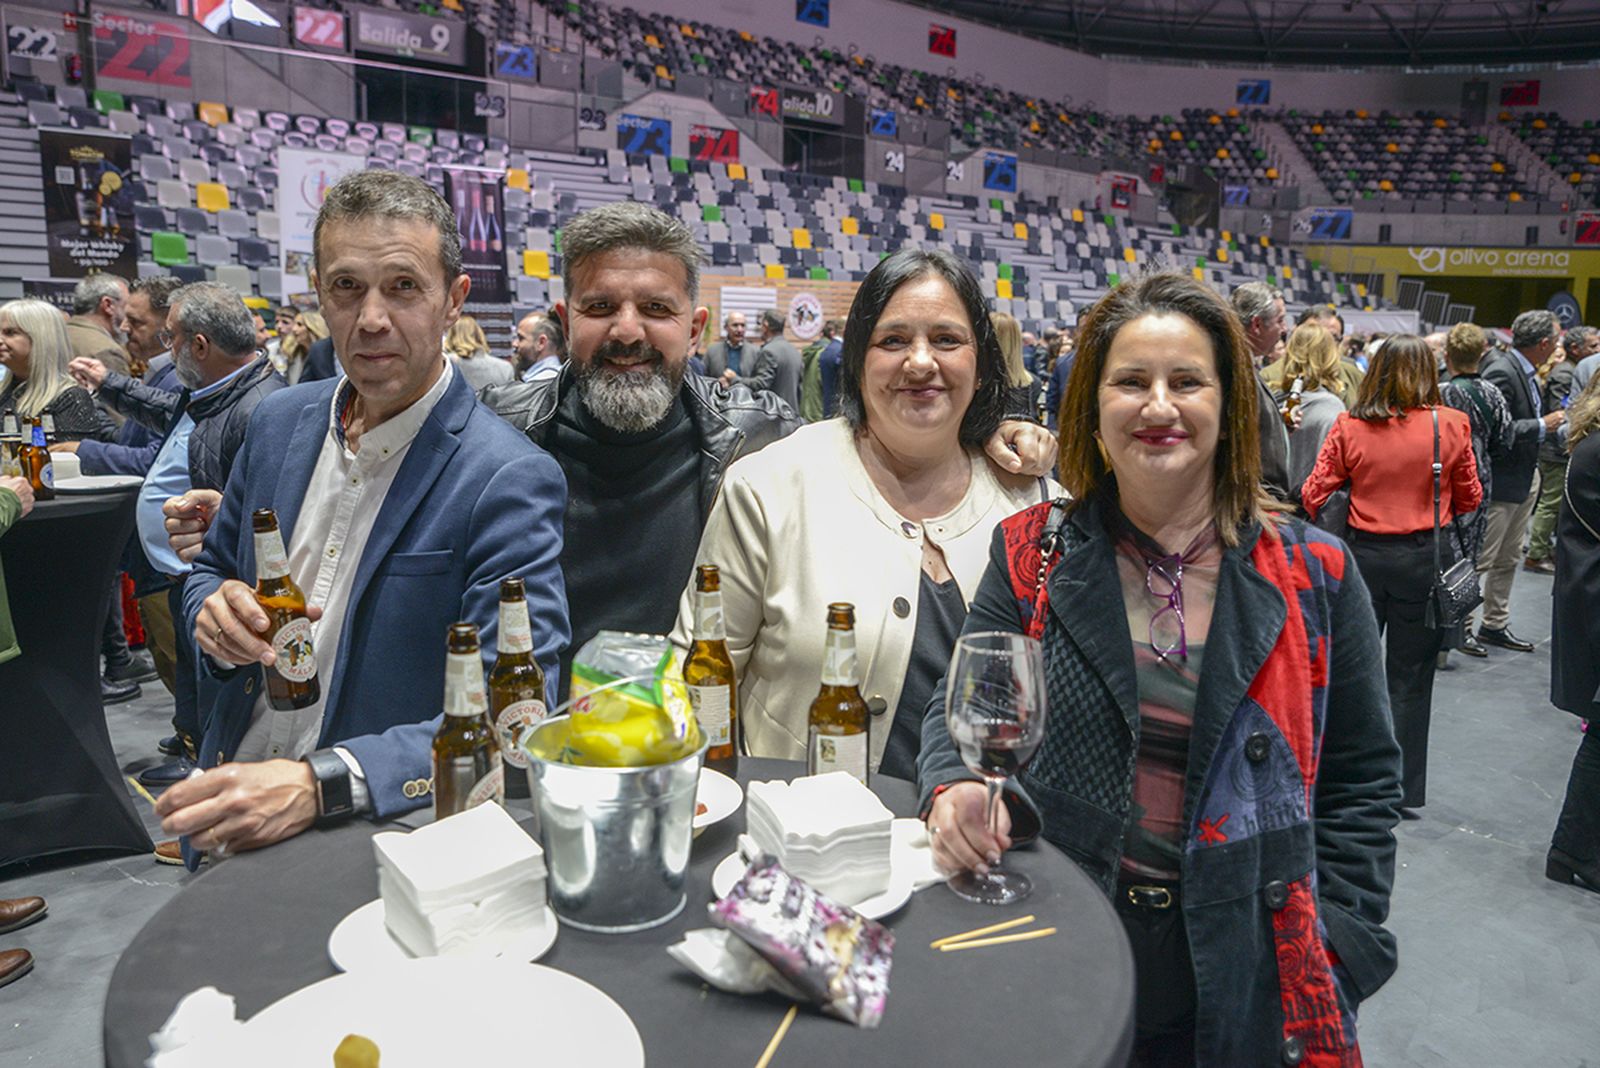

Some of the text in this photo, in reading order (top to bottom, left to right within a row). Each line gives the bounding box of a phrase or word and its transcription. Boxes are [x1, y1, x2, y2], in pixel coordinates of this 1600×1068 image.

[94, 13, 156, 36] Sector
[293, 9, 344, 49] 22
[358, 20, 450, 52] Salida 9
[8, 26, 58, 62] 22
[95, 15, 192, 88] 22
[783, 92, 833, 116] alida 10
[617, 114, 672, 157] 23
[689, 125, 739, 163] 24
[884, 151, 905, 173] 24
[1311, 208, 1353, 240] 27
[1449, 247, 1569, 267] olivo arena
